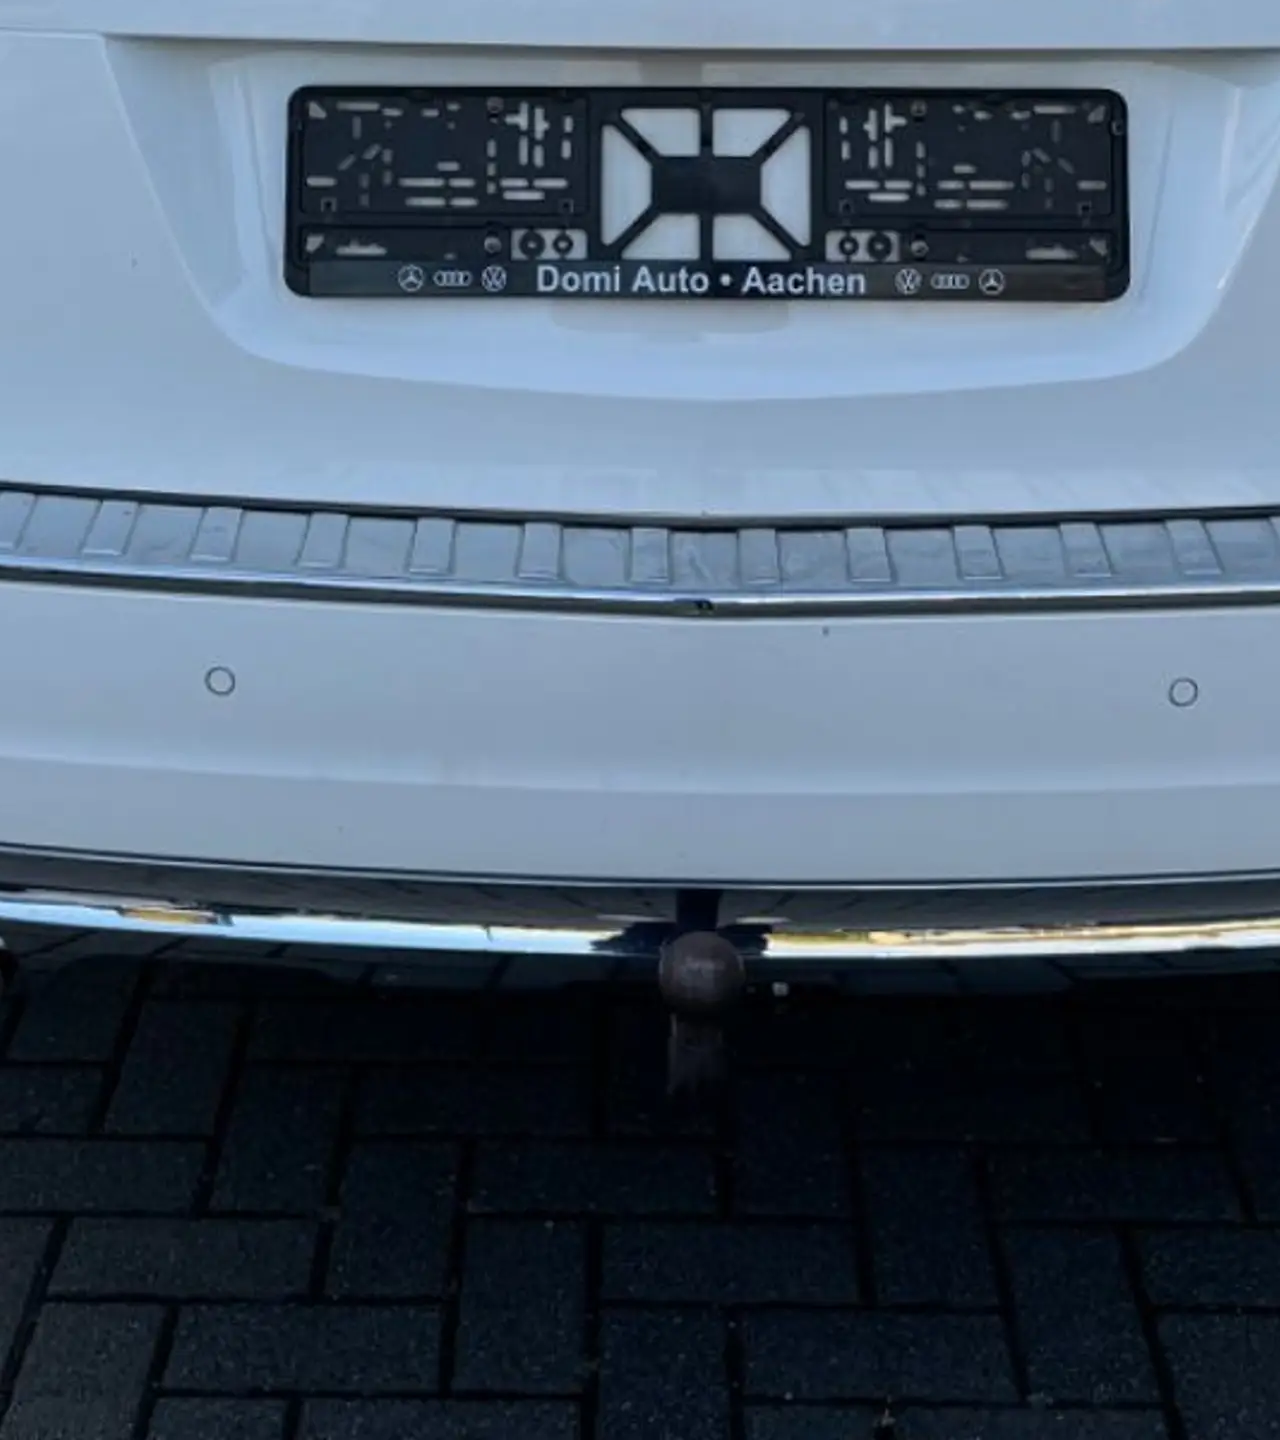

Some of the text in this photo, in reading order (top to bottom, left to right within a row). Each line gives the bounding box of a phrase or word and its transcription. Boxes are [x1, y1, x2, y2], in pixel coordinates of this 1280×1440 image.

[537, 264, 867, 295] Domi Auto Aachen
